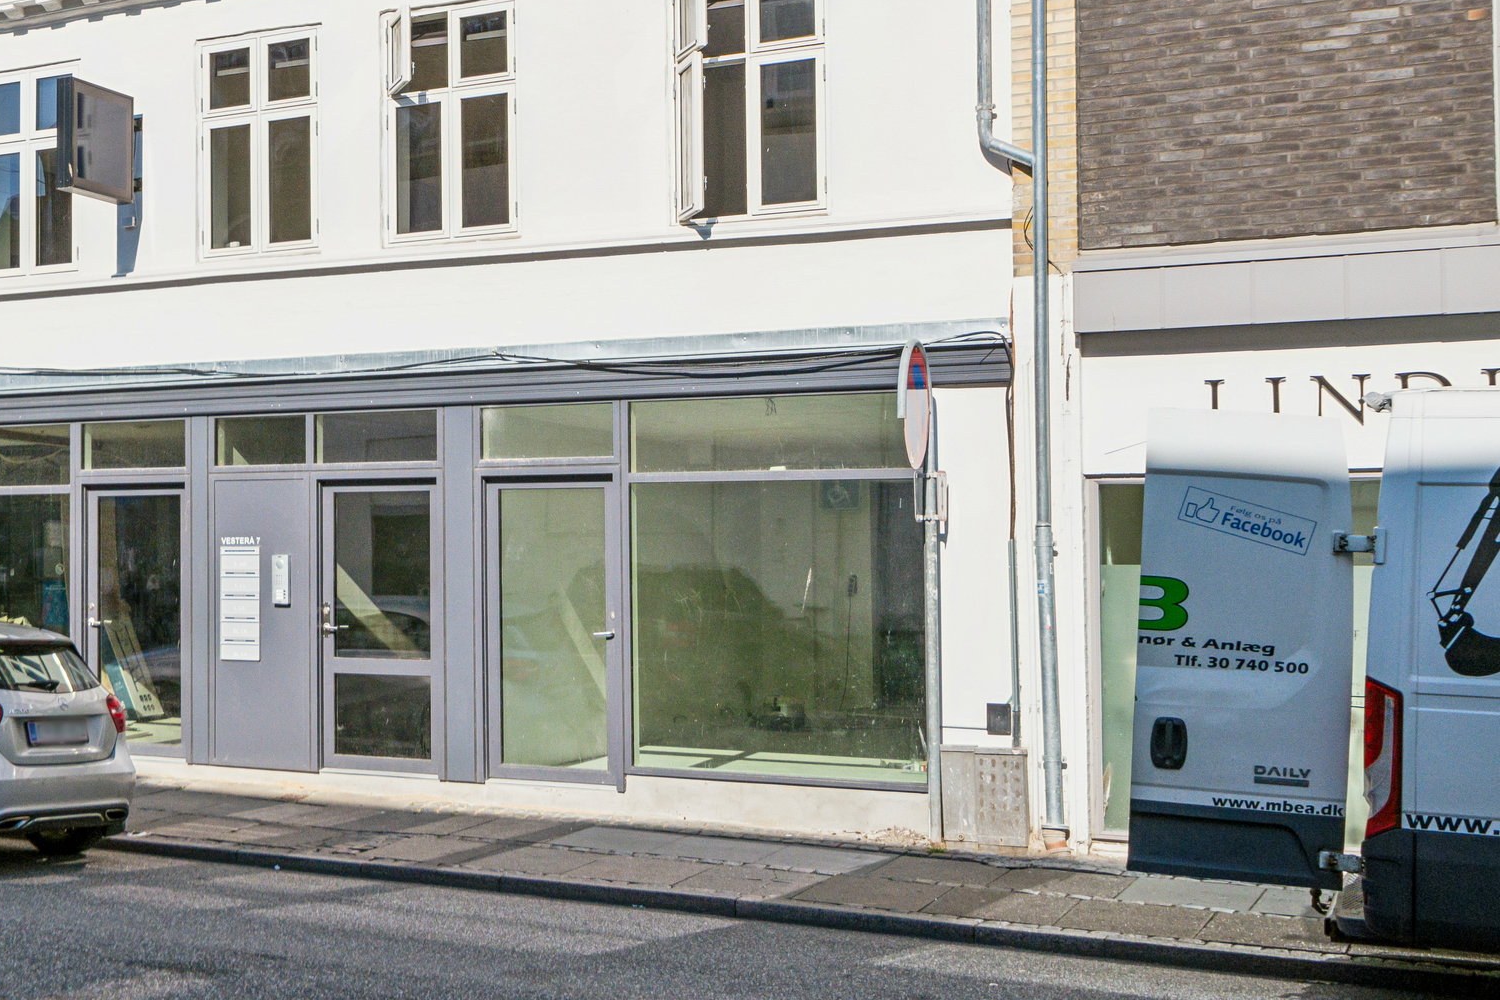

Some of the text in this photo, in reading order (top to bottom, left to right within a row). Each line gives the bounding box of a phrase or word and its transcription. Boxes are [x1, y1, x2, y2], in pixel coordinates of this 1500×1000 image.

[1254, 513, 1266, 521] os
[1221, 512, 1305, 548] Facebook
[1138, 575, 1189, 631] B
[1181, 637, 1196, 648] &
[1202, 638, 1276, 657] Anlæg
[1174, 654, 1309, 674] Tlf. 30 740 500
[1254, 764, 1311, 779] DAILY
[1212, 797, 1344, 817] www.mbea.dk
